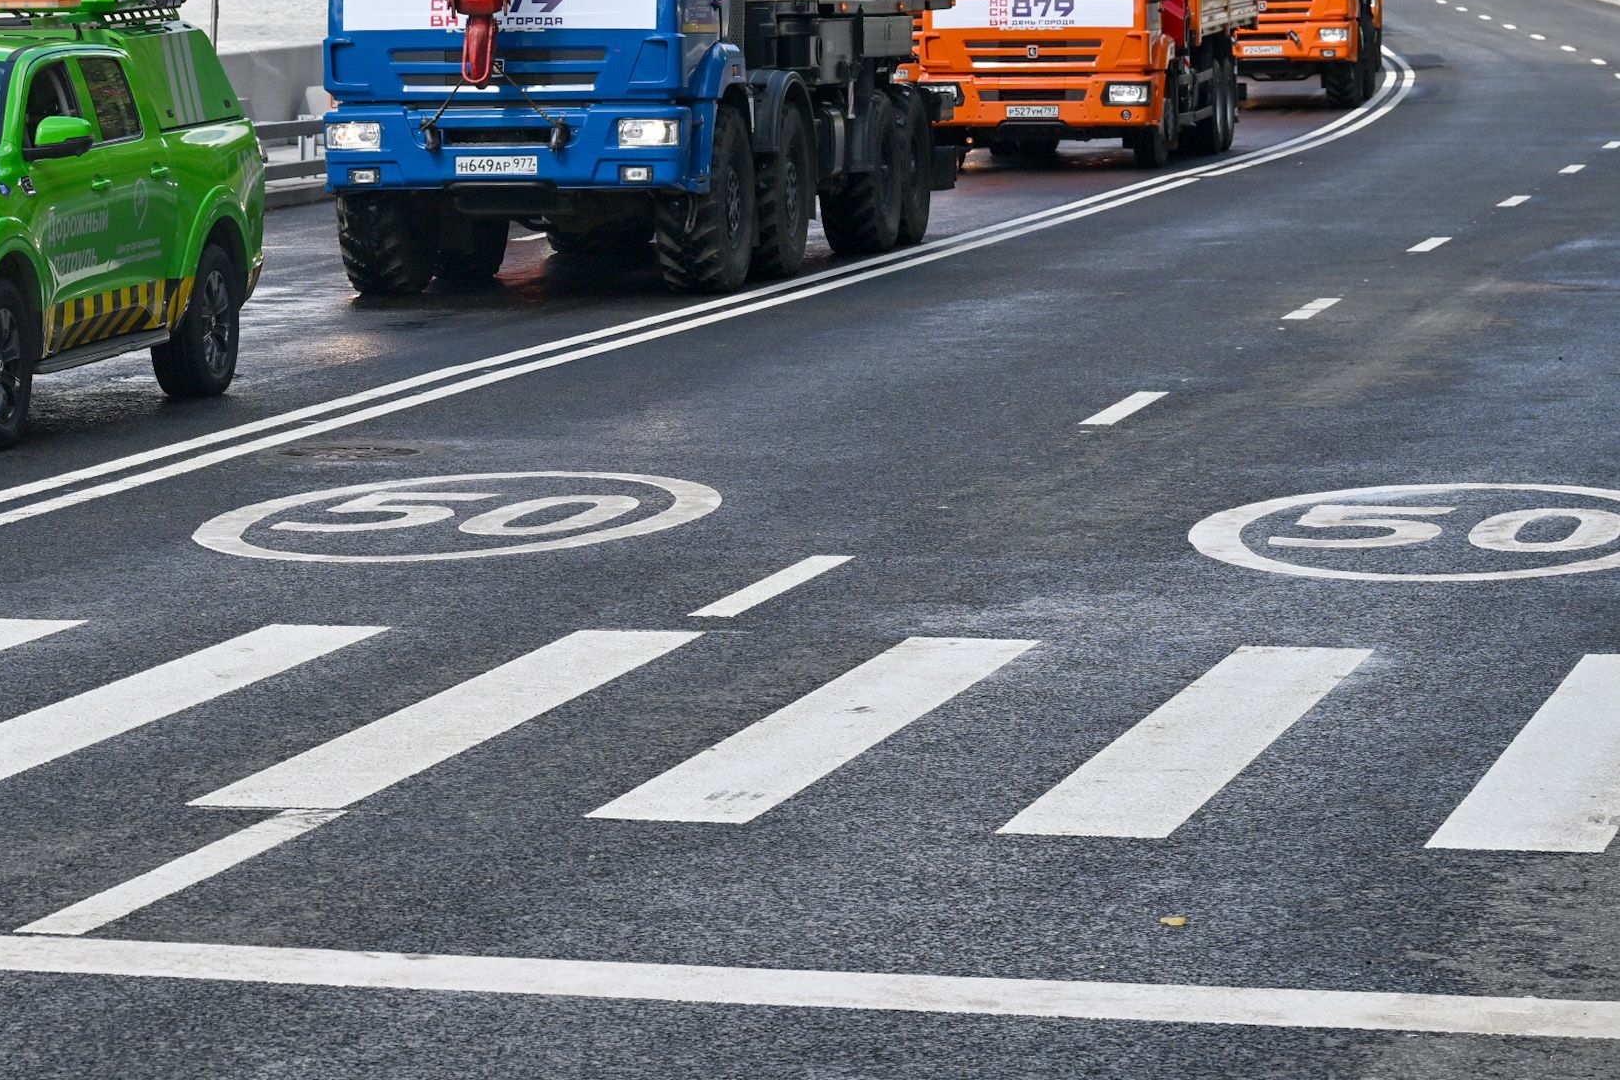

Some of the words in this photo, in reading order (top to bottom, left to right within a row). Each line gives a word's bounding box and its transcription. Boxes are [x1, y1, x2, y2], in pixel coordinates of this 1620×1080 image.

[507, 17, 563, 26] ГОРОДА
[460, 159, 511, 172] Н649АР
[513, 158, 533, 168] 977
[47, 201, 109, 248] Дорожный
[268, 491, 640, 535] 50
[1268, 505, 1620, 552] 50
